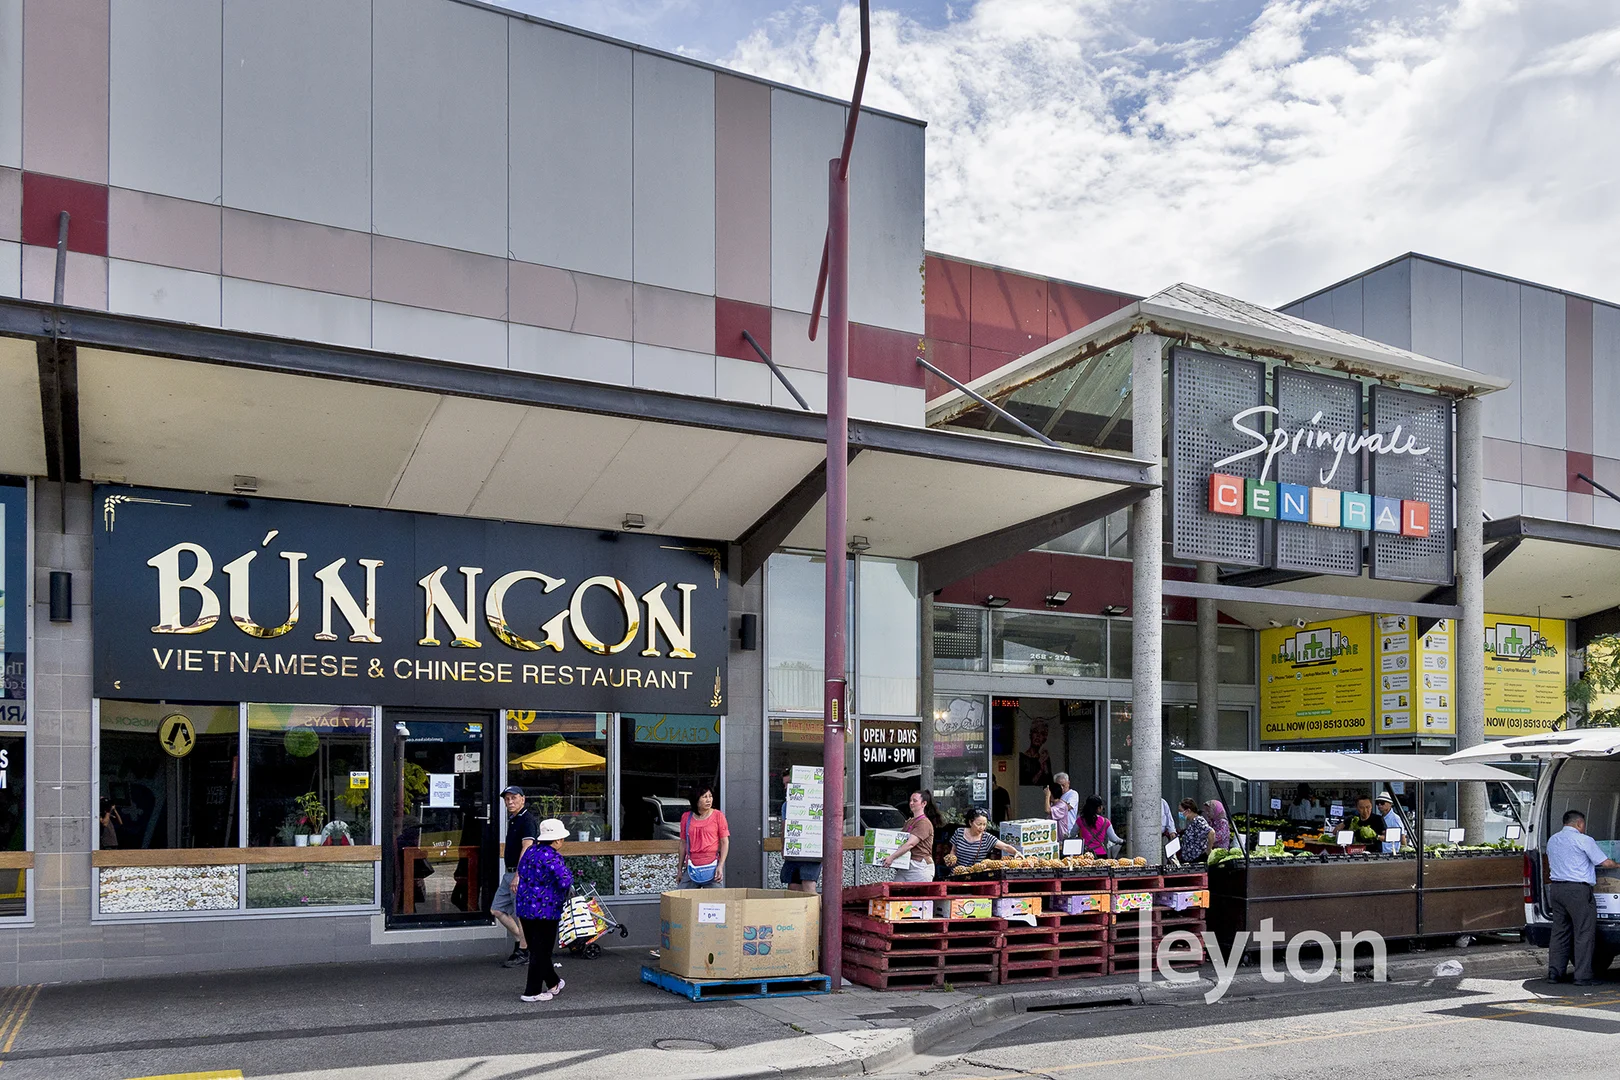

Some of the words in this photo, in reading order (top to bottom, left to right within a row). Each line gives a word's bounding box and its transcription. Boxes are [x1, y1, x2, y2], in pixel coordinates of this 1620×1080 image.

[1213, 405, 1431, 486] Springvale
[1216, 483, 1425, 531] CENTRAL
[146, 529, 384, 643] BÚN
[418, 565, 697, 658] NGON
[152, 648, 358, 678] VIETNAMESE
[367, 658, 385, 678] &
[394, 658, 513, 683] CHINESE
[522, 665, 693, 690] RESTAURANT
[1266, 723, 1286, 732] CALL
[1286, 721, 1305, 731] NOW
[1306, 720, 1322, 731] (03)
[1323, 719, 1342, 729] 8513
[1343, 718, 1365, 728] 0380
[1486, 717, 1506, 727] NOW
[1507, 718, 1522, 728] (03)
[1523, 719, 1541, 728] 8513
[863, 728, 885, 743] OPEN
[889, 729, 894, 743] 7
[897, 729, 917, 743] DAYS
[863, 748, 887, 762] 9AM
[893, 748, 915, 763] 9PM
[776, 923, 794, 933] Opal.
